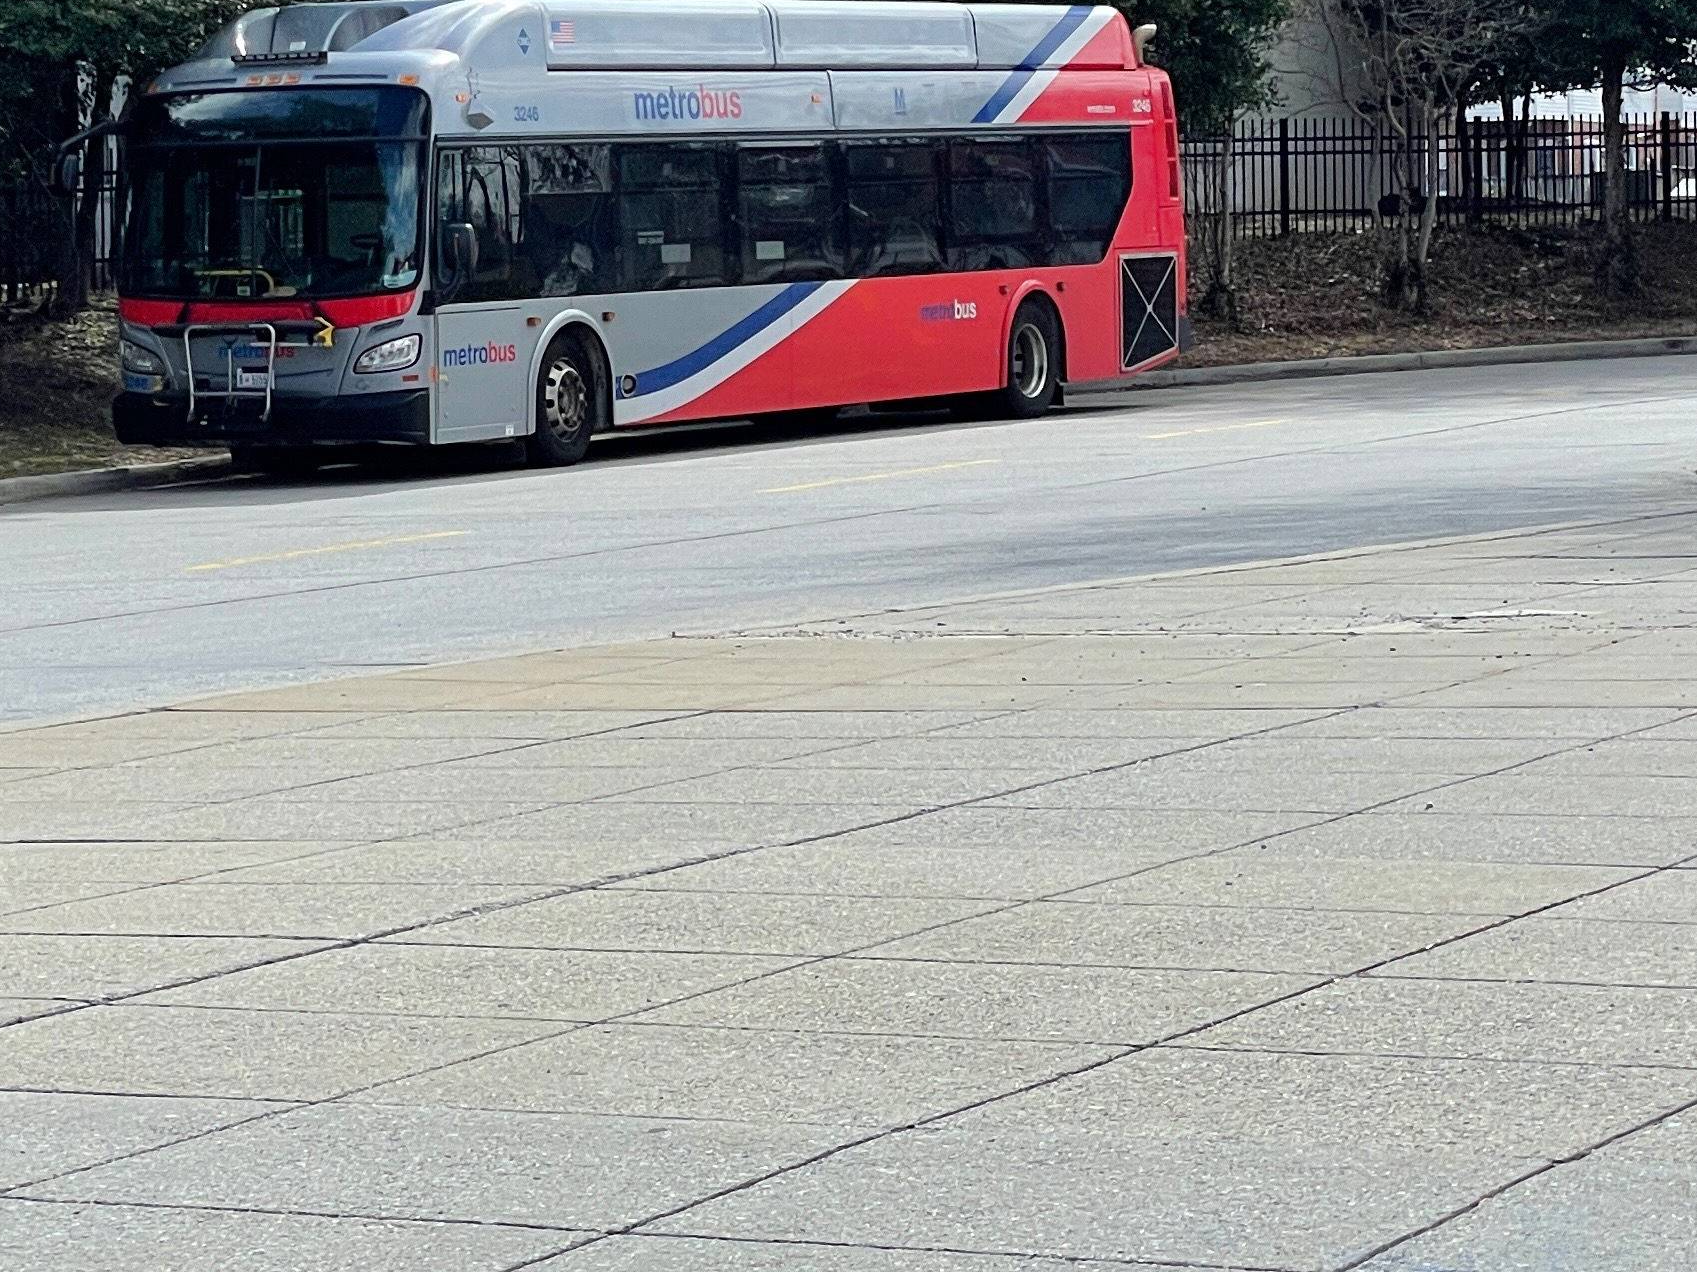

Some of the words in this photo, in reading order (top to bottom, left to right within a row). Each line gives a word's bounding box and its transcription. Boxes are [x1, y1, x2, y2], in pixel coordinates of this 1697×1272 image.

[514, 106, 539, 121] 3246
[633, 83, 742, 120] metrobus
[443, 341, 516, 367] metrobus
